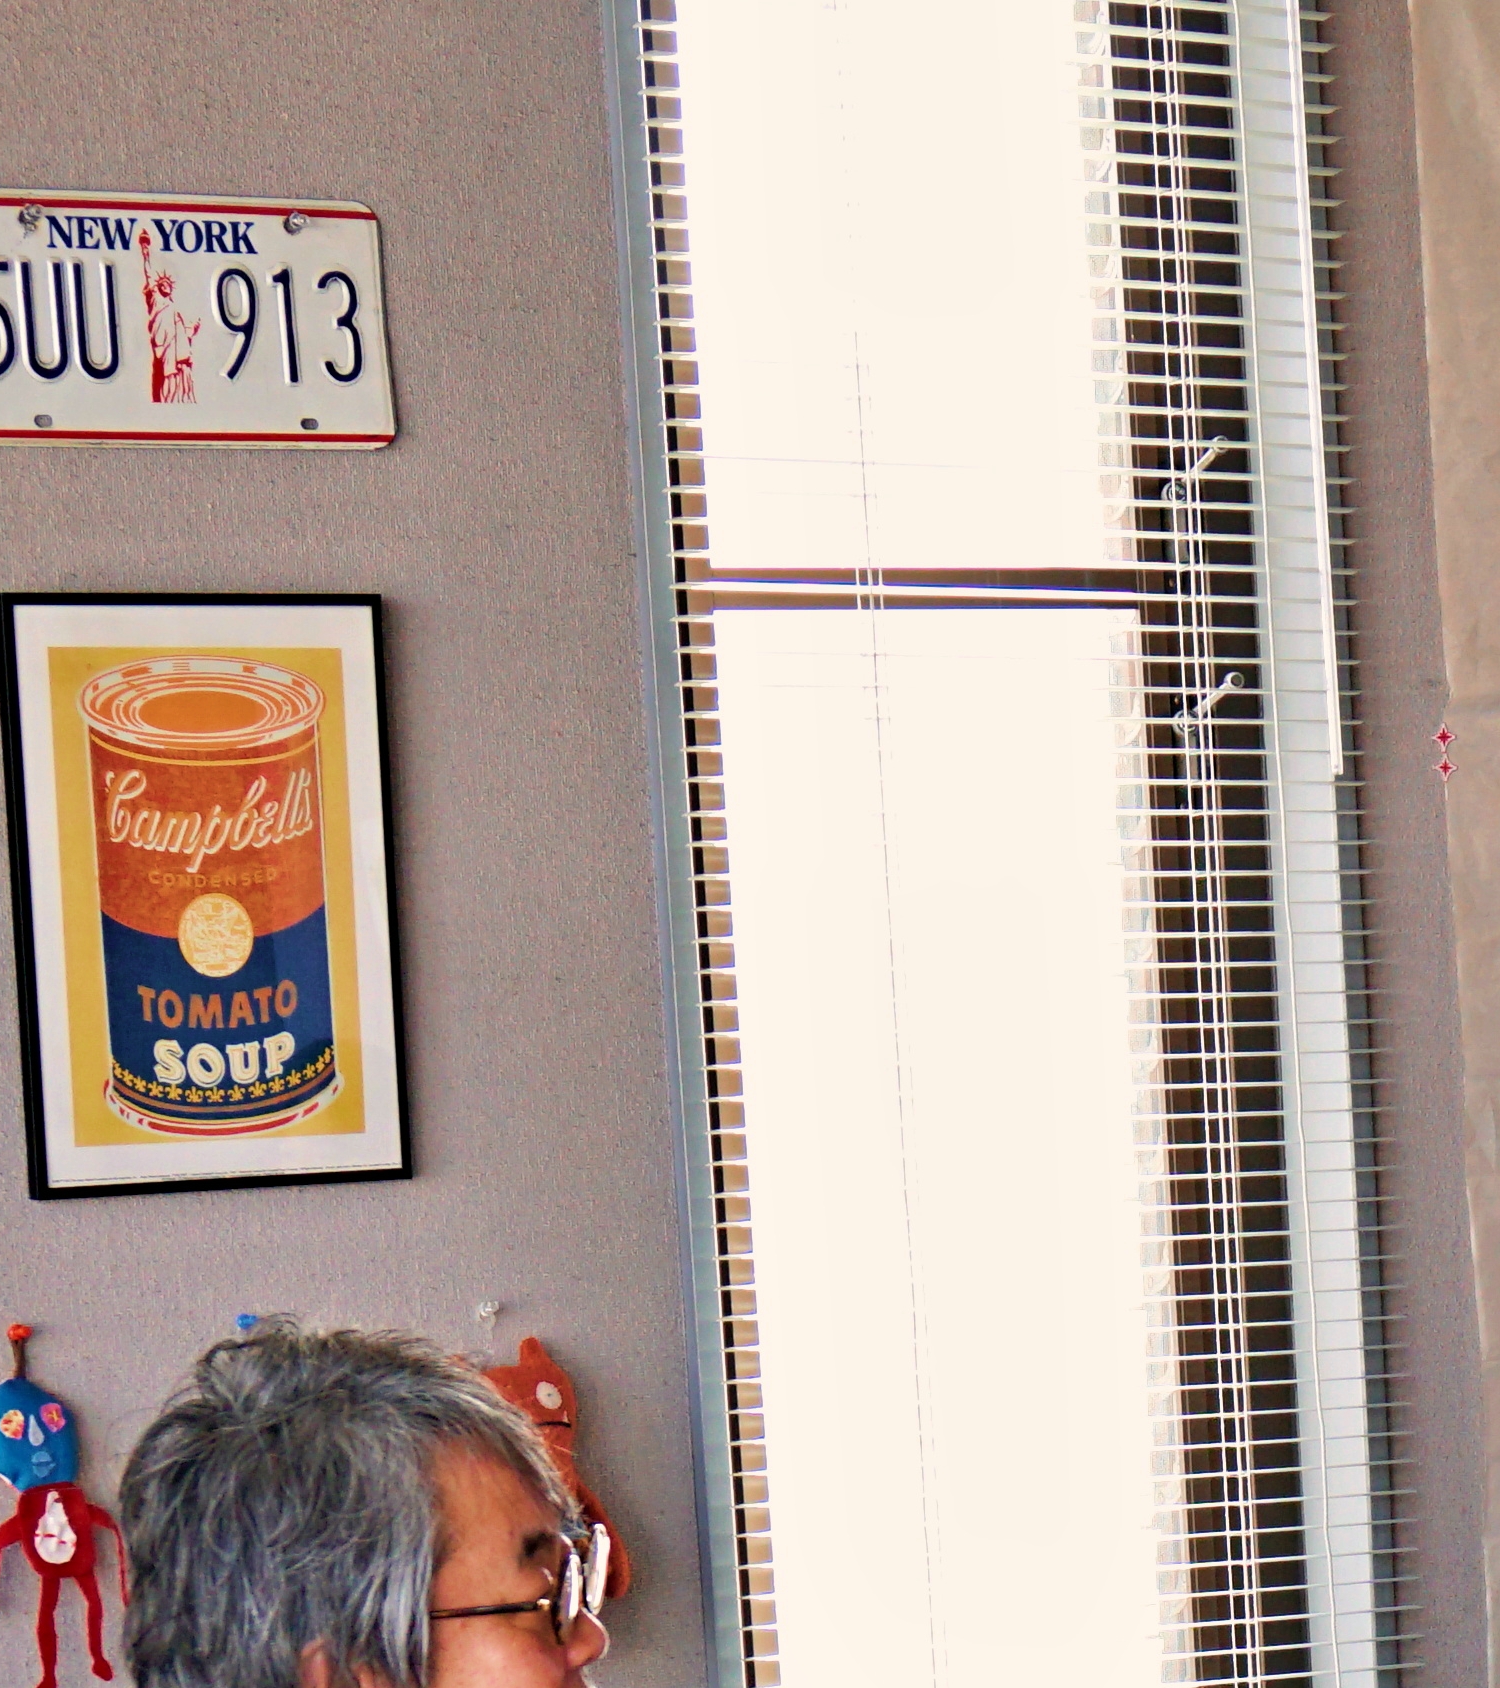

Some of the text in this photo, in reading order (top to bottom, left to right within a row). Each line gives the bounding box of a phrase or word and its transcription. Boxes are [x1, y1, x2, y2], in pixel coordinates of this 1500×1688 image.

[47, 214, 258, 255] NEW YORK
[214, 265, 365, 385] 913
[148, 867, 278, 888] CONDENSED
[137, 978, 299, 1030] TOMATO
[153, 1031, 296, 1084] SOUP
